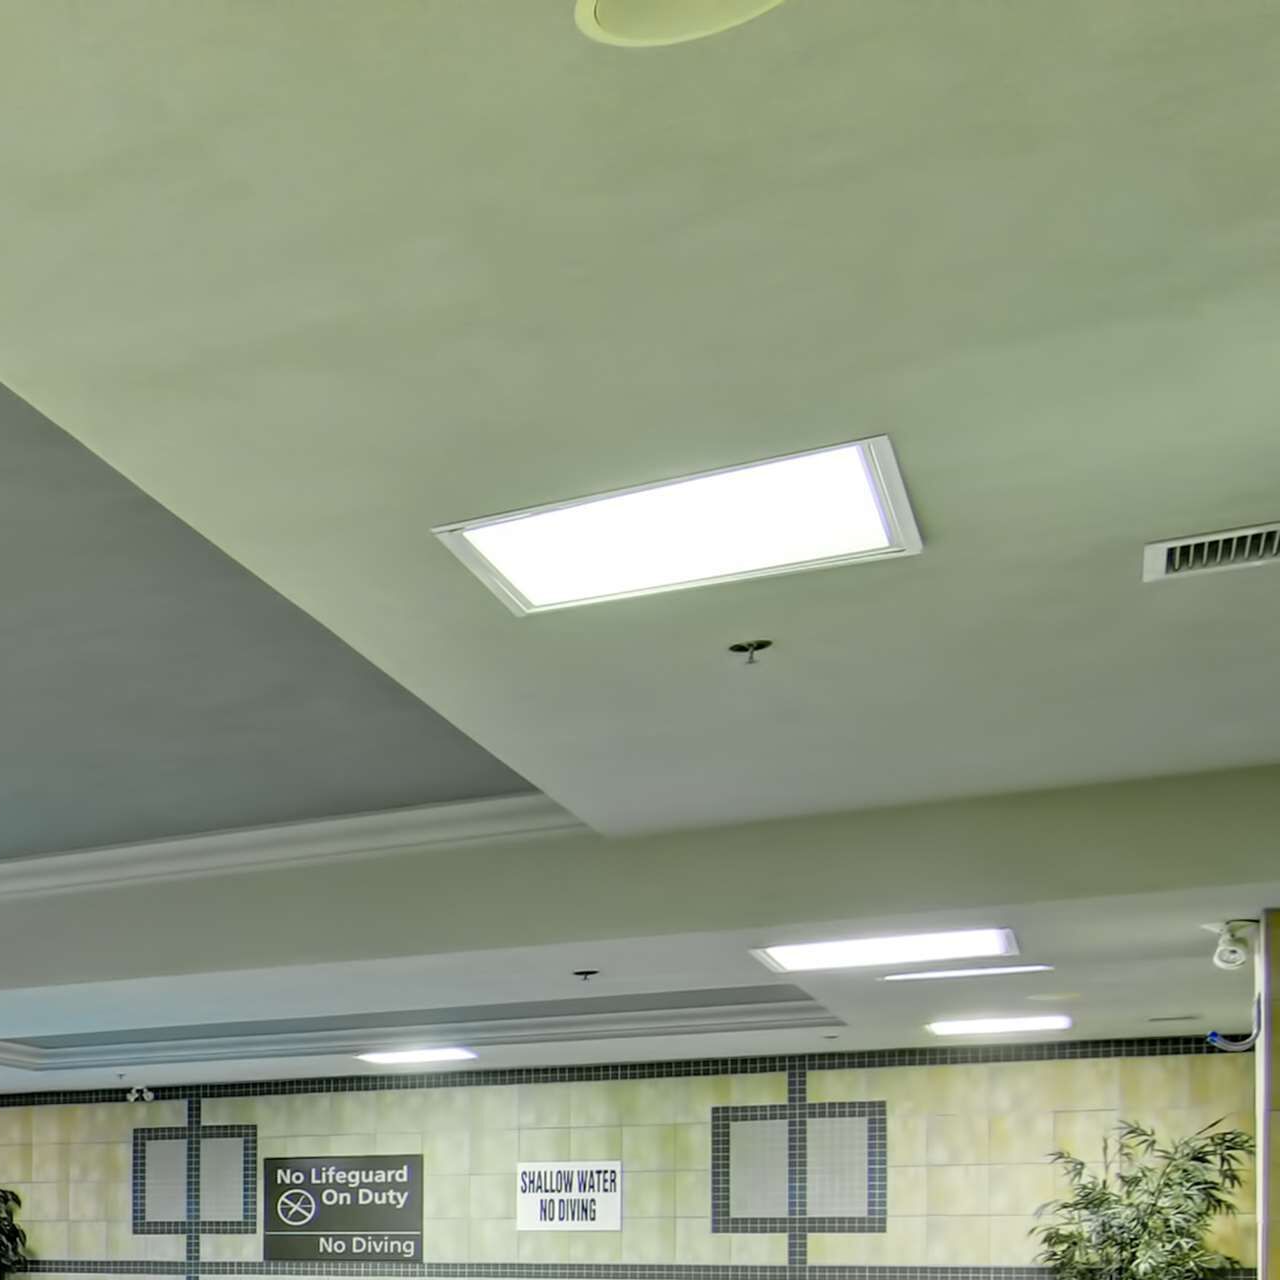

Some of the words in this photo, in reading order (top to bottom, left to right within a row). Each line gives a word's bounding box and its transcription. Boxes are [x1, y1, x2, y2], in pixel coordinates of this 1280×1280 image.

[277, 1168, 304, 1184] No
[311, 1165, 408, 1187] Lifeguard
[521, 1169, 574, 1194] SHALLOW
[577, 1169, 617, 1193] WATER
[322, 1188, 351, 1206] On
[358, 1188, 409, 1209] Duty
[539, 1198, 555, 1222] NO
[558, 1197, 597, 1222] DIVING
[319, 1236, 346, 1254] No
[352, 1235, 415, 1258] Diving
